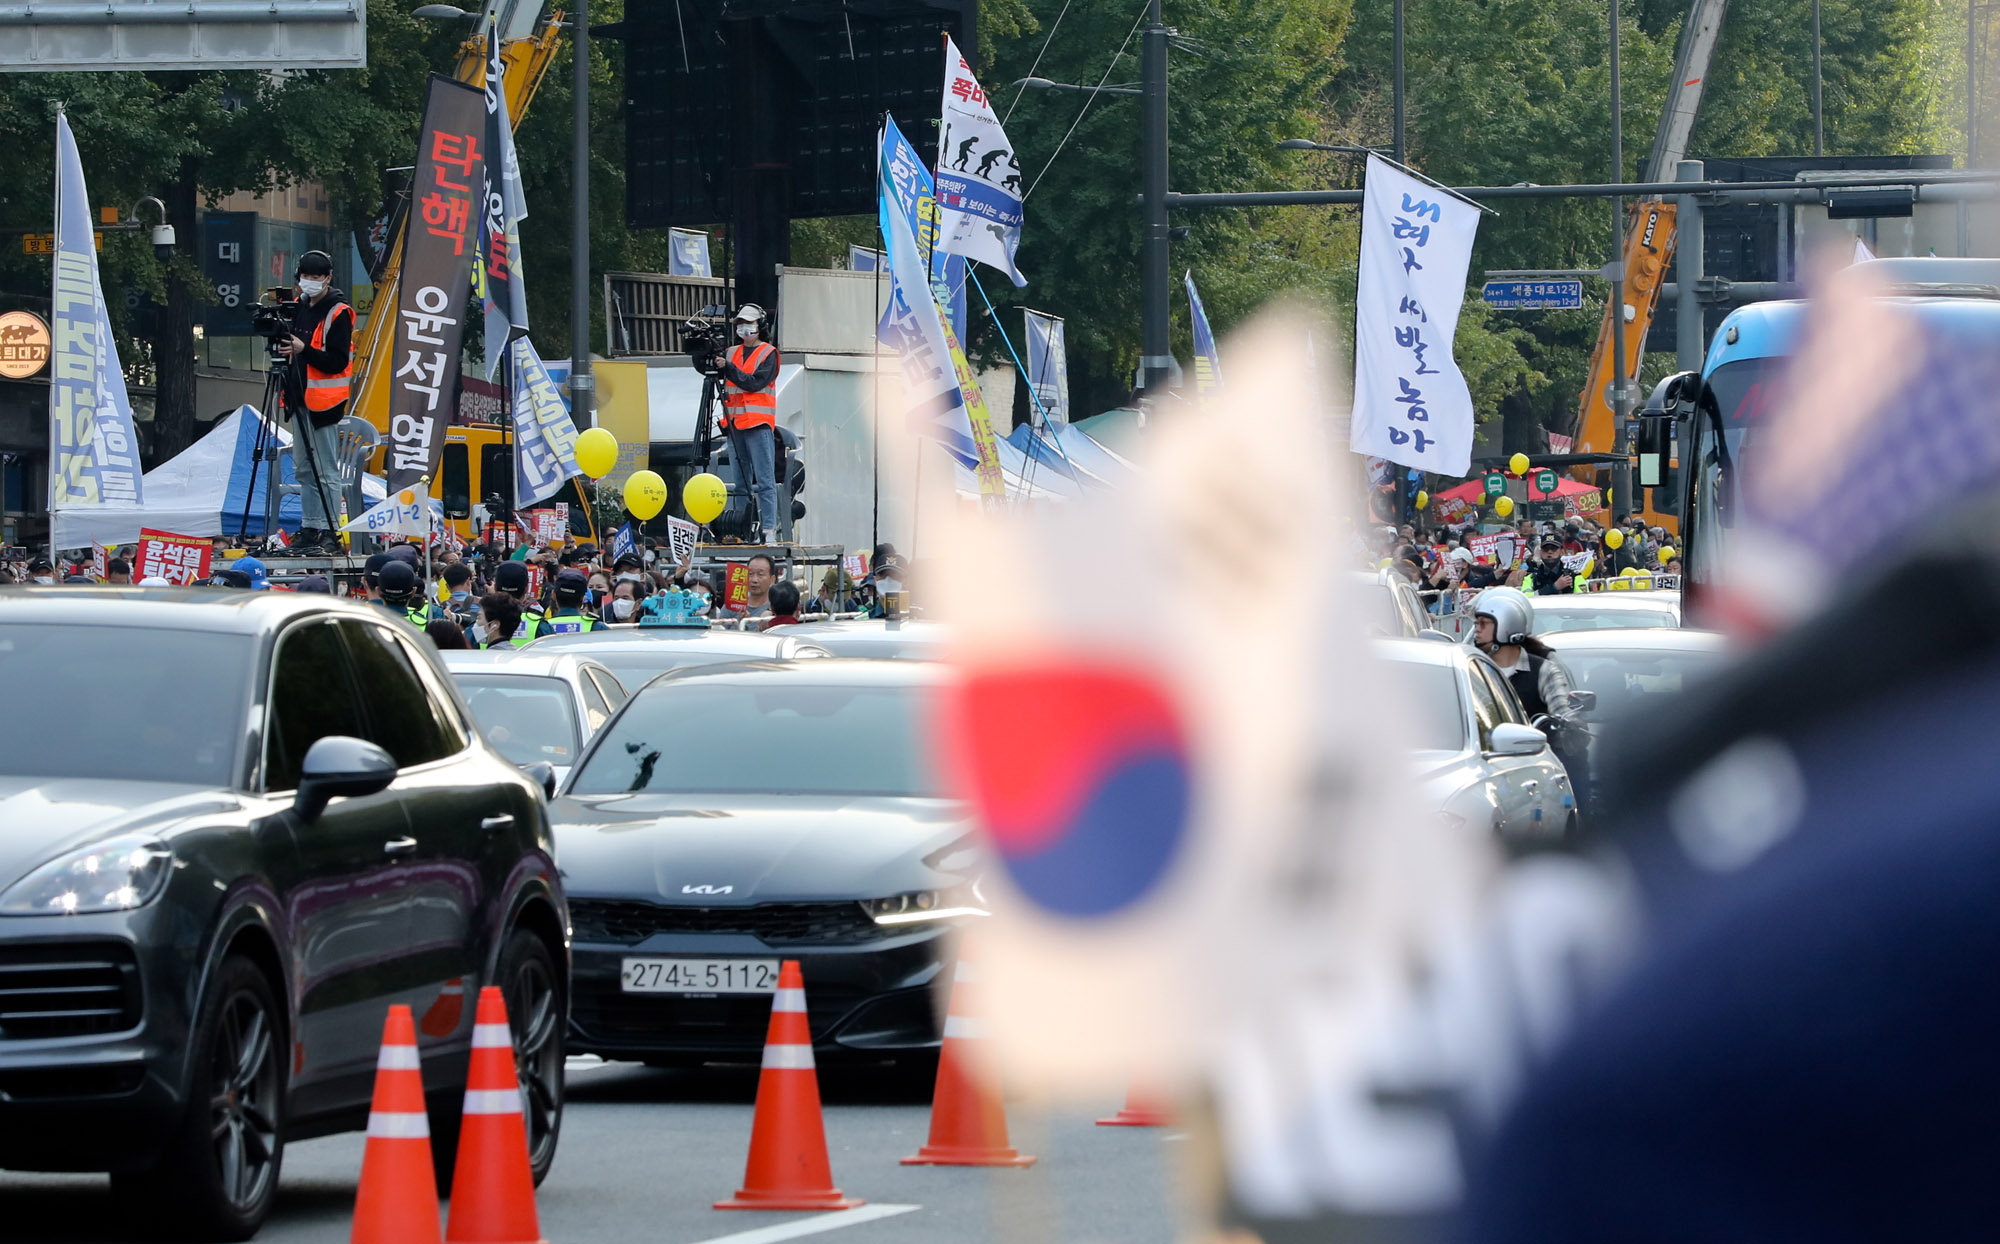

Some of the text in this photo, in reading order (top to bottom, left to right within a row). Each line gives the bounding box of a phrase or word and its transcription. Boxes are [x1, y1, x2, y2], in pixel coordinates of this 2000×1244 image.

[967, 200, 997, 217] 보이는
[1642, 213, 1657, 246] KATO
[1512, 284, 1578, 297] 세종대로12길
[391, 130, 484, 472] 탄핵 윤석열
[146, 540, 202, 567] 윤석열
[1471, 543, 1496, 557] 김건
[655, 598, 692, 610] 개인
[662, 612, 686, 624] 서울
[632, 963, 769, 989] 274노 5112
